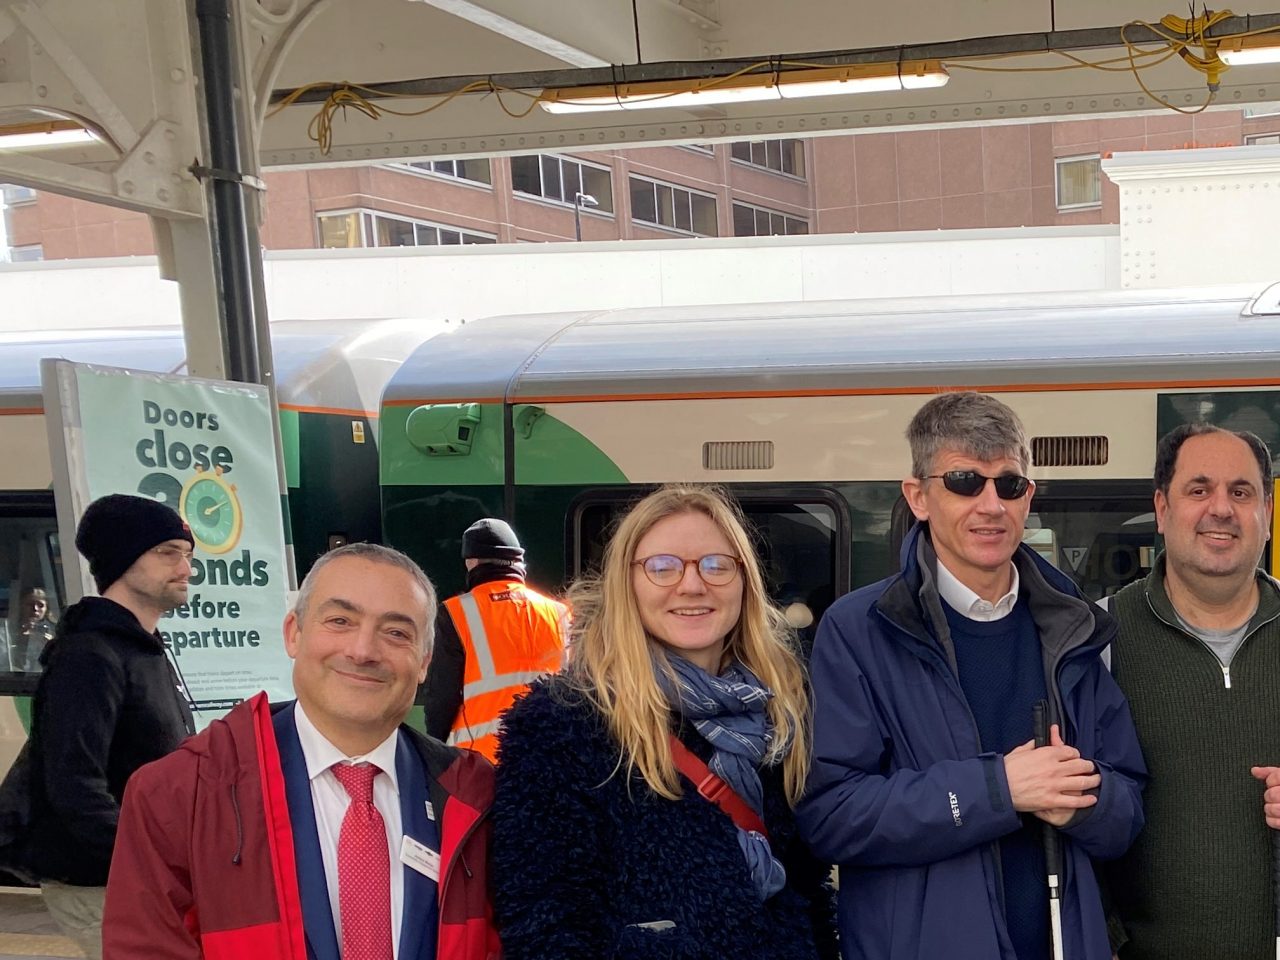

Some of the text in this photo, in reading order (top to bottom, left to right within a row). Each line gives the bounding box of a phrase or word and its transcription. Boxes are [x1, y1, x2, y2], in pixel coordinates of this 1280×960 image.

[143, 400, 219, 431] Doors
[136, 429, 233, 474] close
[188, 549, 269, 587] onds
[160, 628, 260, 656] eparture
